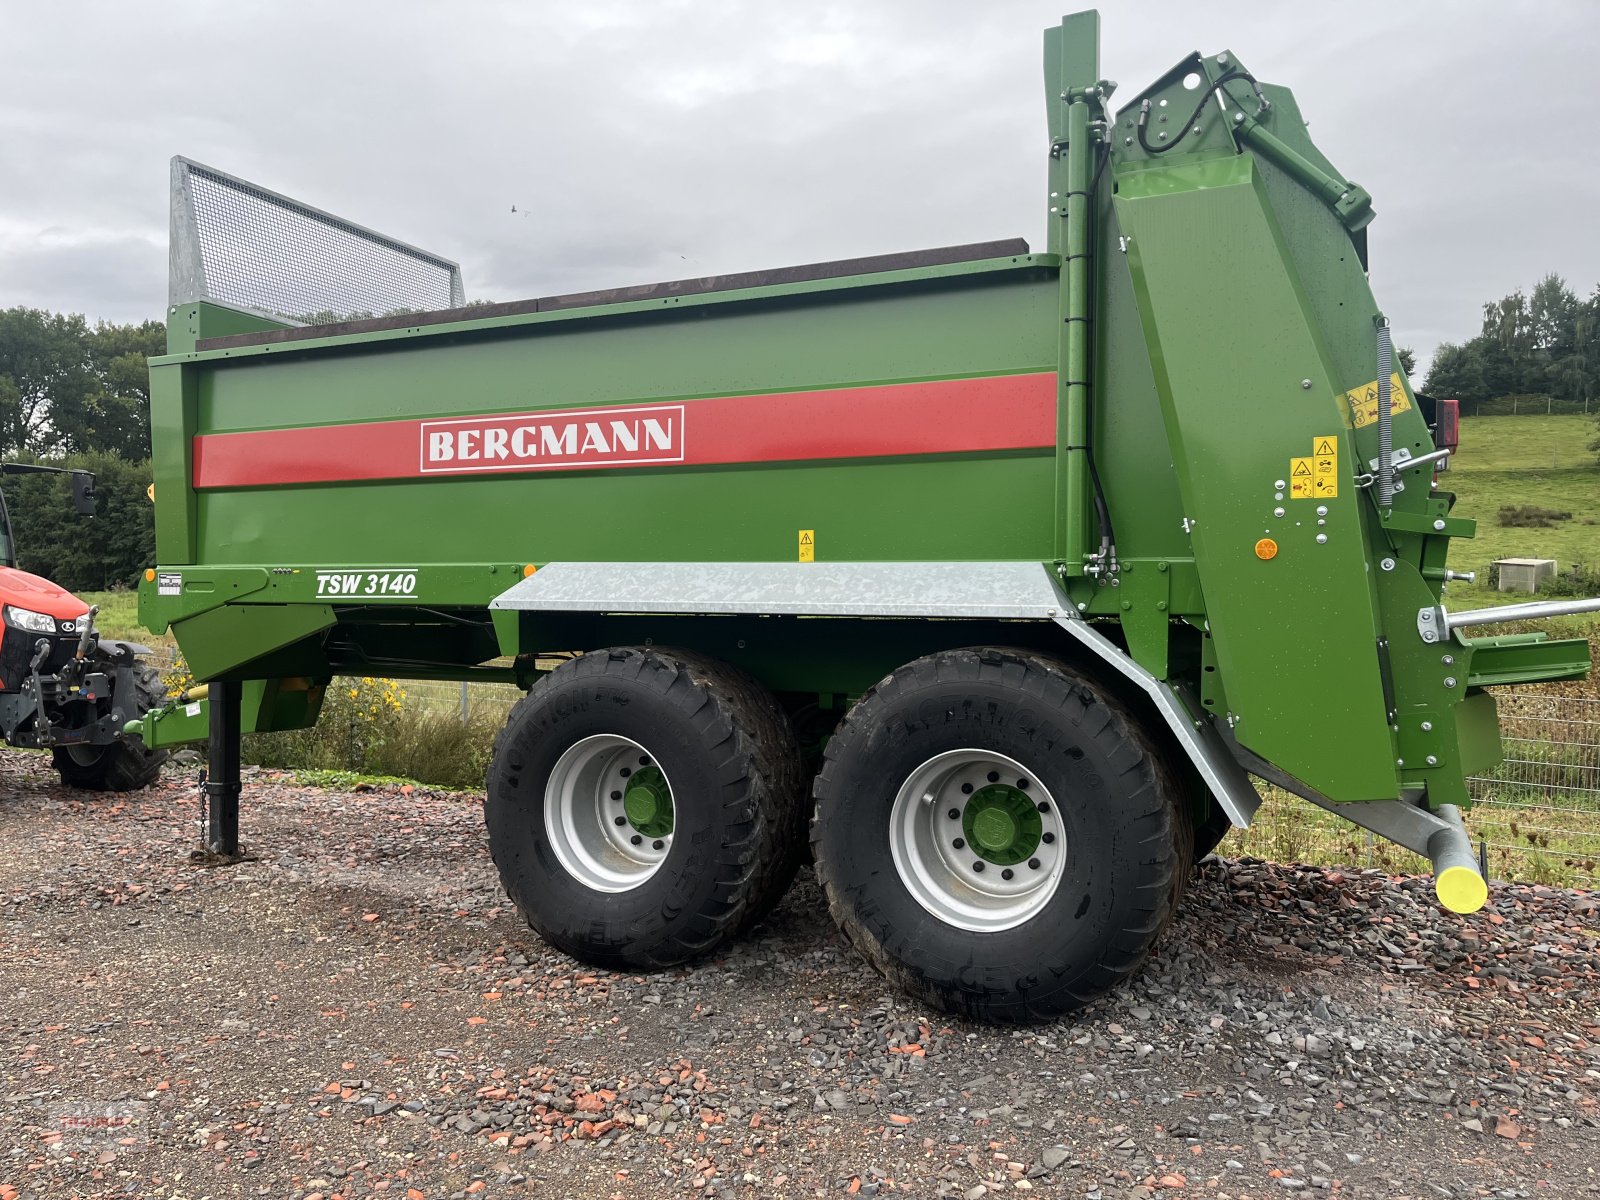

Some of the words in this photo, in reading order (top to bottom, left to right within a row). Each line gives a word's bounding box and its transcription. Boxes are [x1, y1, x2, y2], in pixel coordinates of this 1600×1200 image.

[429, 418, 672, 461] BERGMANN
[317, 574, 361, 594] TSW
[364, 573, 416, 594] 3140
